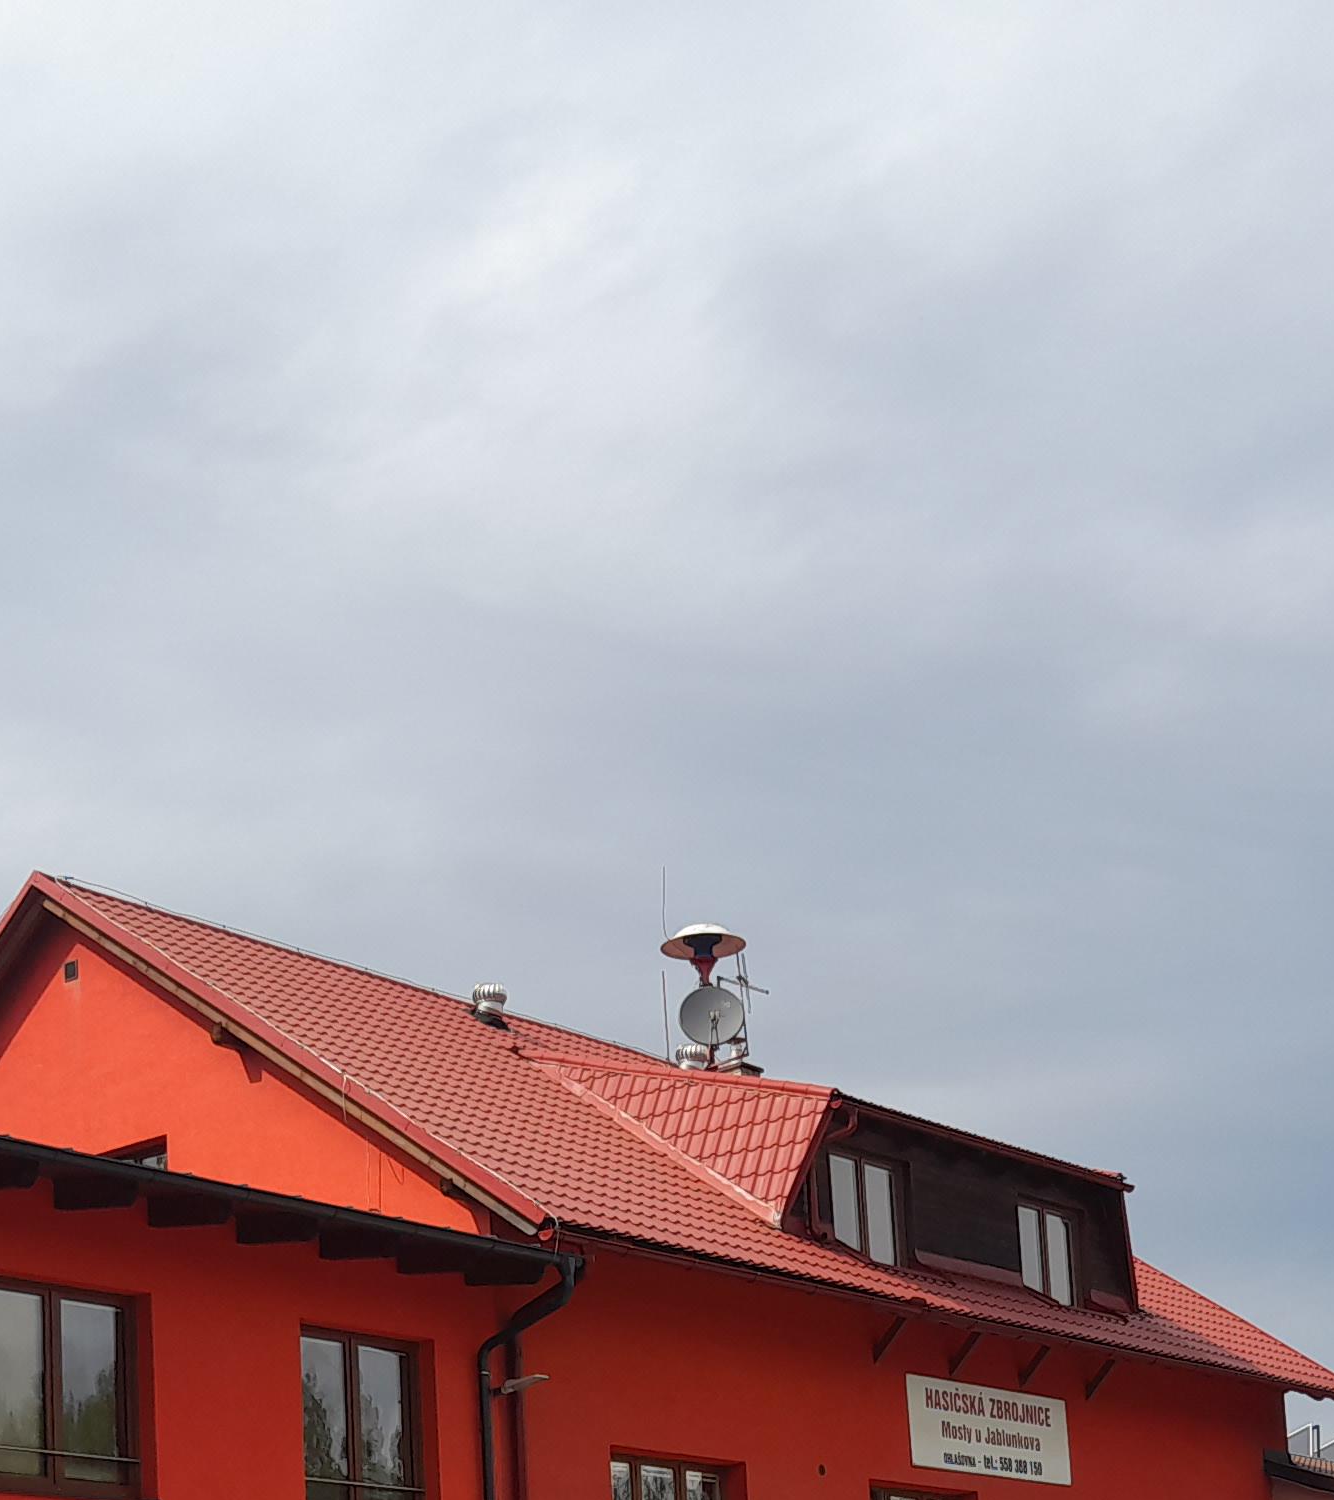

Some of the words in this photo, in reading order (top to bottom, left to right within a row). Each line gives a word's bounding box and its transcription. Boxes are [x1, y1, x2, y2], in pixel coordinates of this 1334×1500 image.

[925, 1387, 985, 1417] HASIČSKÁ
[990, 1398, 1051, 1427] ZBROJNICE
[942, 1421, 972, 1443] Mosty
[975, 1428, 981, 1443] u
[985, 1427, 1041, 1452] Jablunkova
